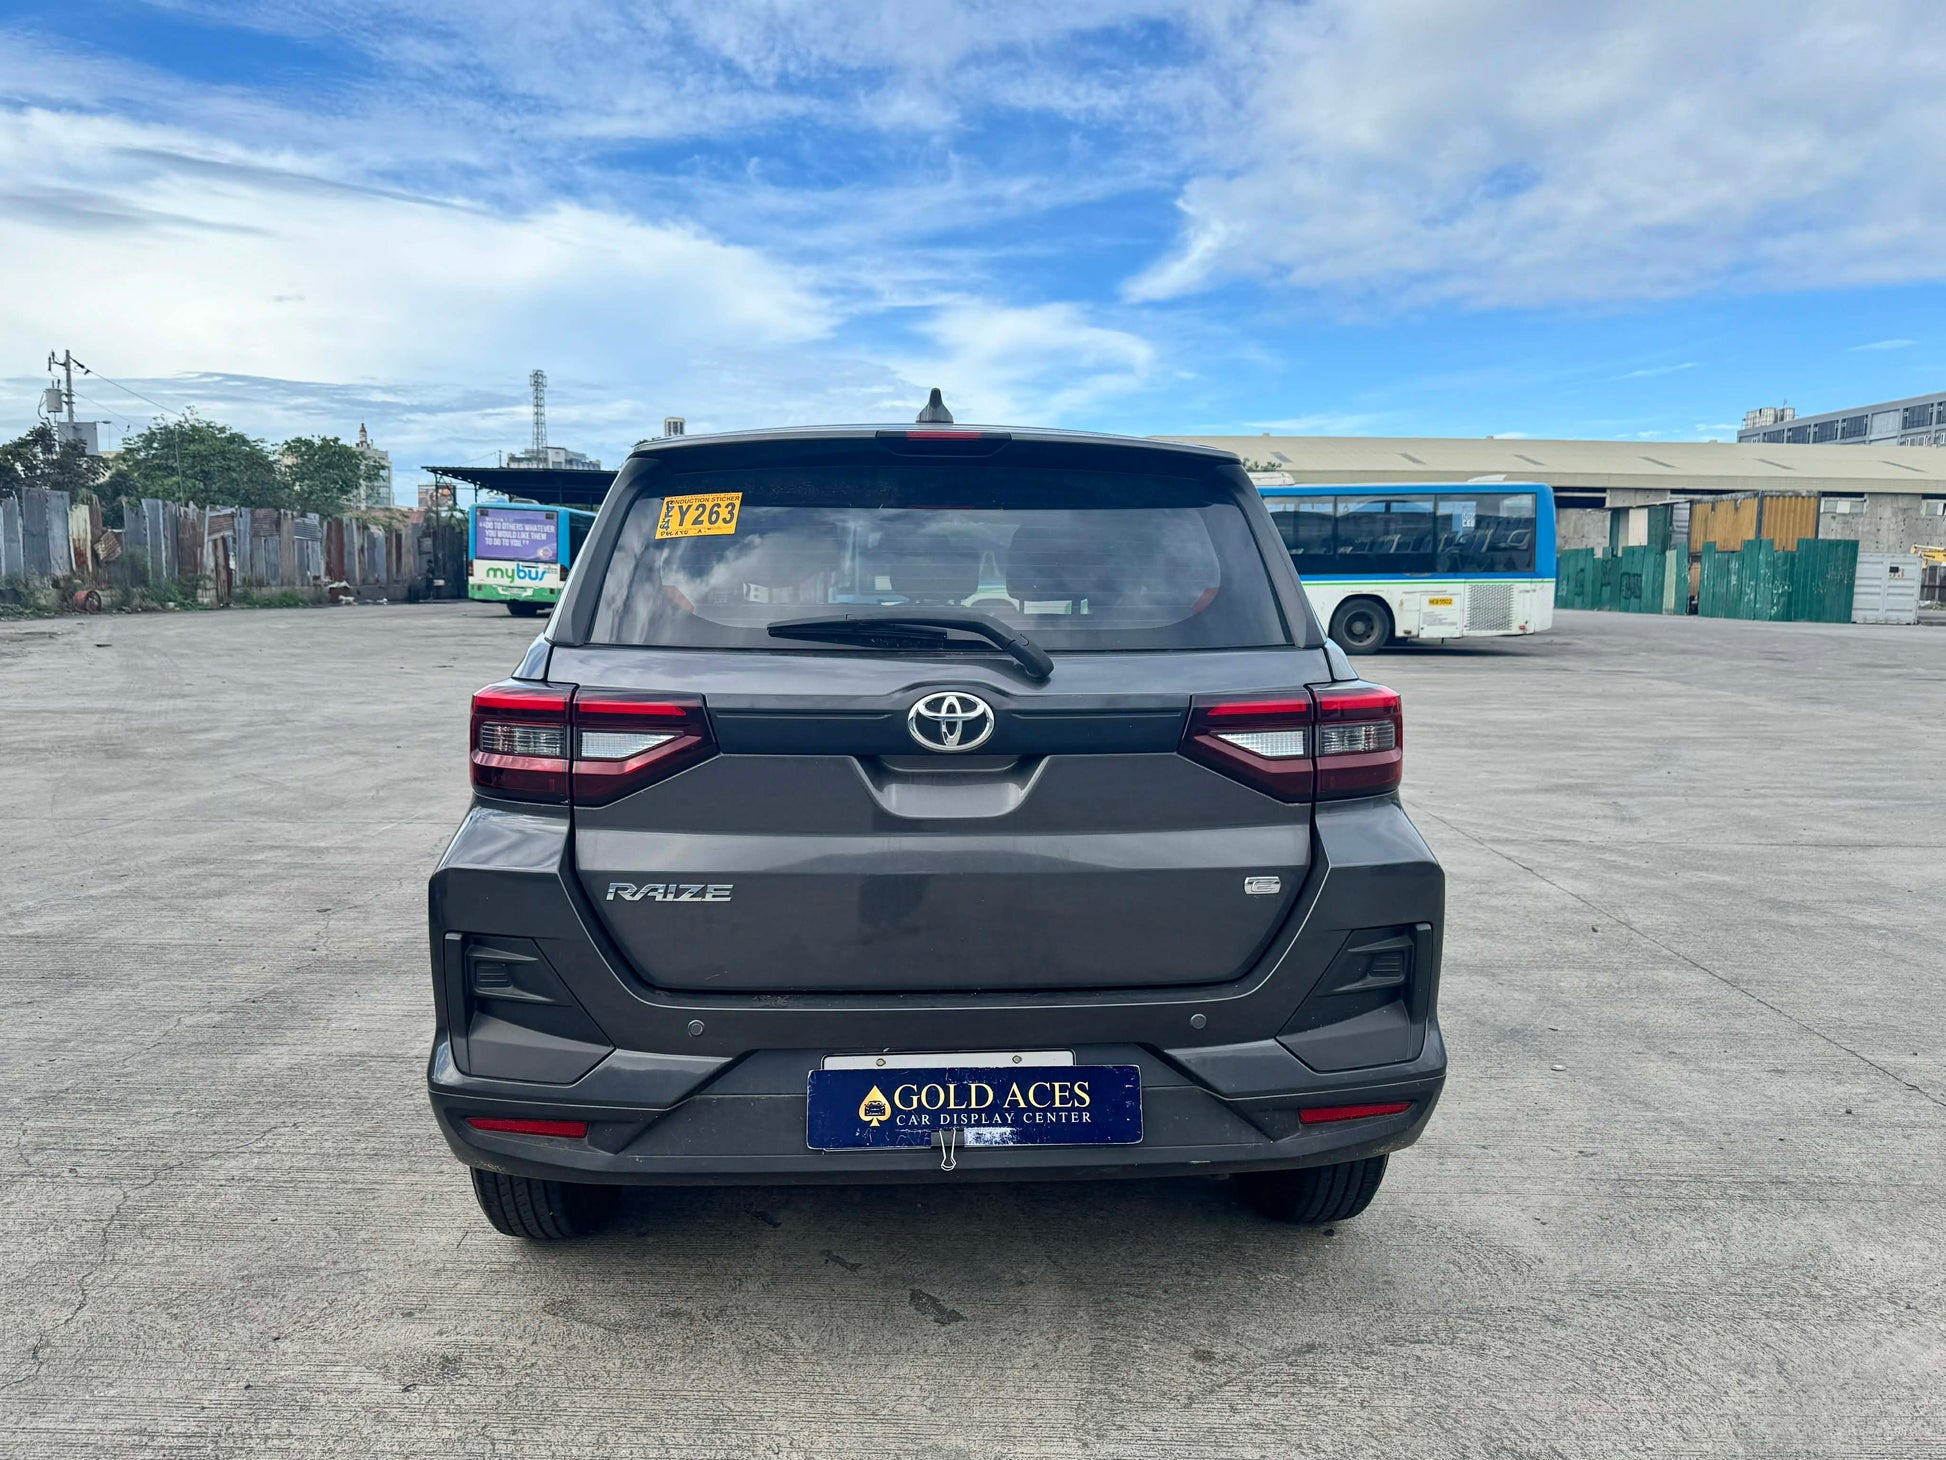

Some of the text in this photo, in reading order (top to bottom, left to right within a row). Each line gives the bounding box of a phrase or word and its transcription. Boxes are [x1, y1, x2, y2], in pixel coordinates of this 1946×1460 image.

[711, 495, 740, 503] STICKER
[677, 502, 736, 527] Y263
[502, 522, 524, 531] OTHERS
[524, 524, 555, 533] WHATEVER
[485, 537, 493, 545] TO
[493, 538, 501, 546] DO
[502, 538, 510, 546] TO
[497, 530, 517, 539] WOULD
[517, 531, 530, 540] LIKE
[530, 532, 547, 541] THEM
[486, 563, 548, 584] mybus
[605, 882, 734, 902] RAIZE
[894, 1081, 1092, 1111] GOLD ACES
[896, 1111, 1093, 1126] CAR DISPLAY CENTER
